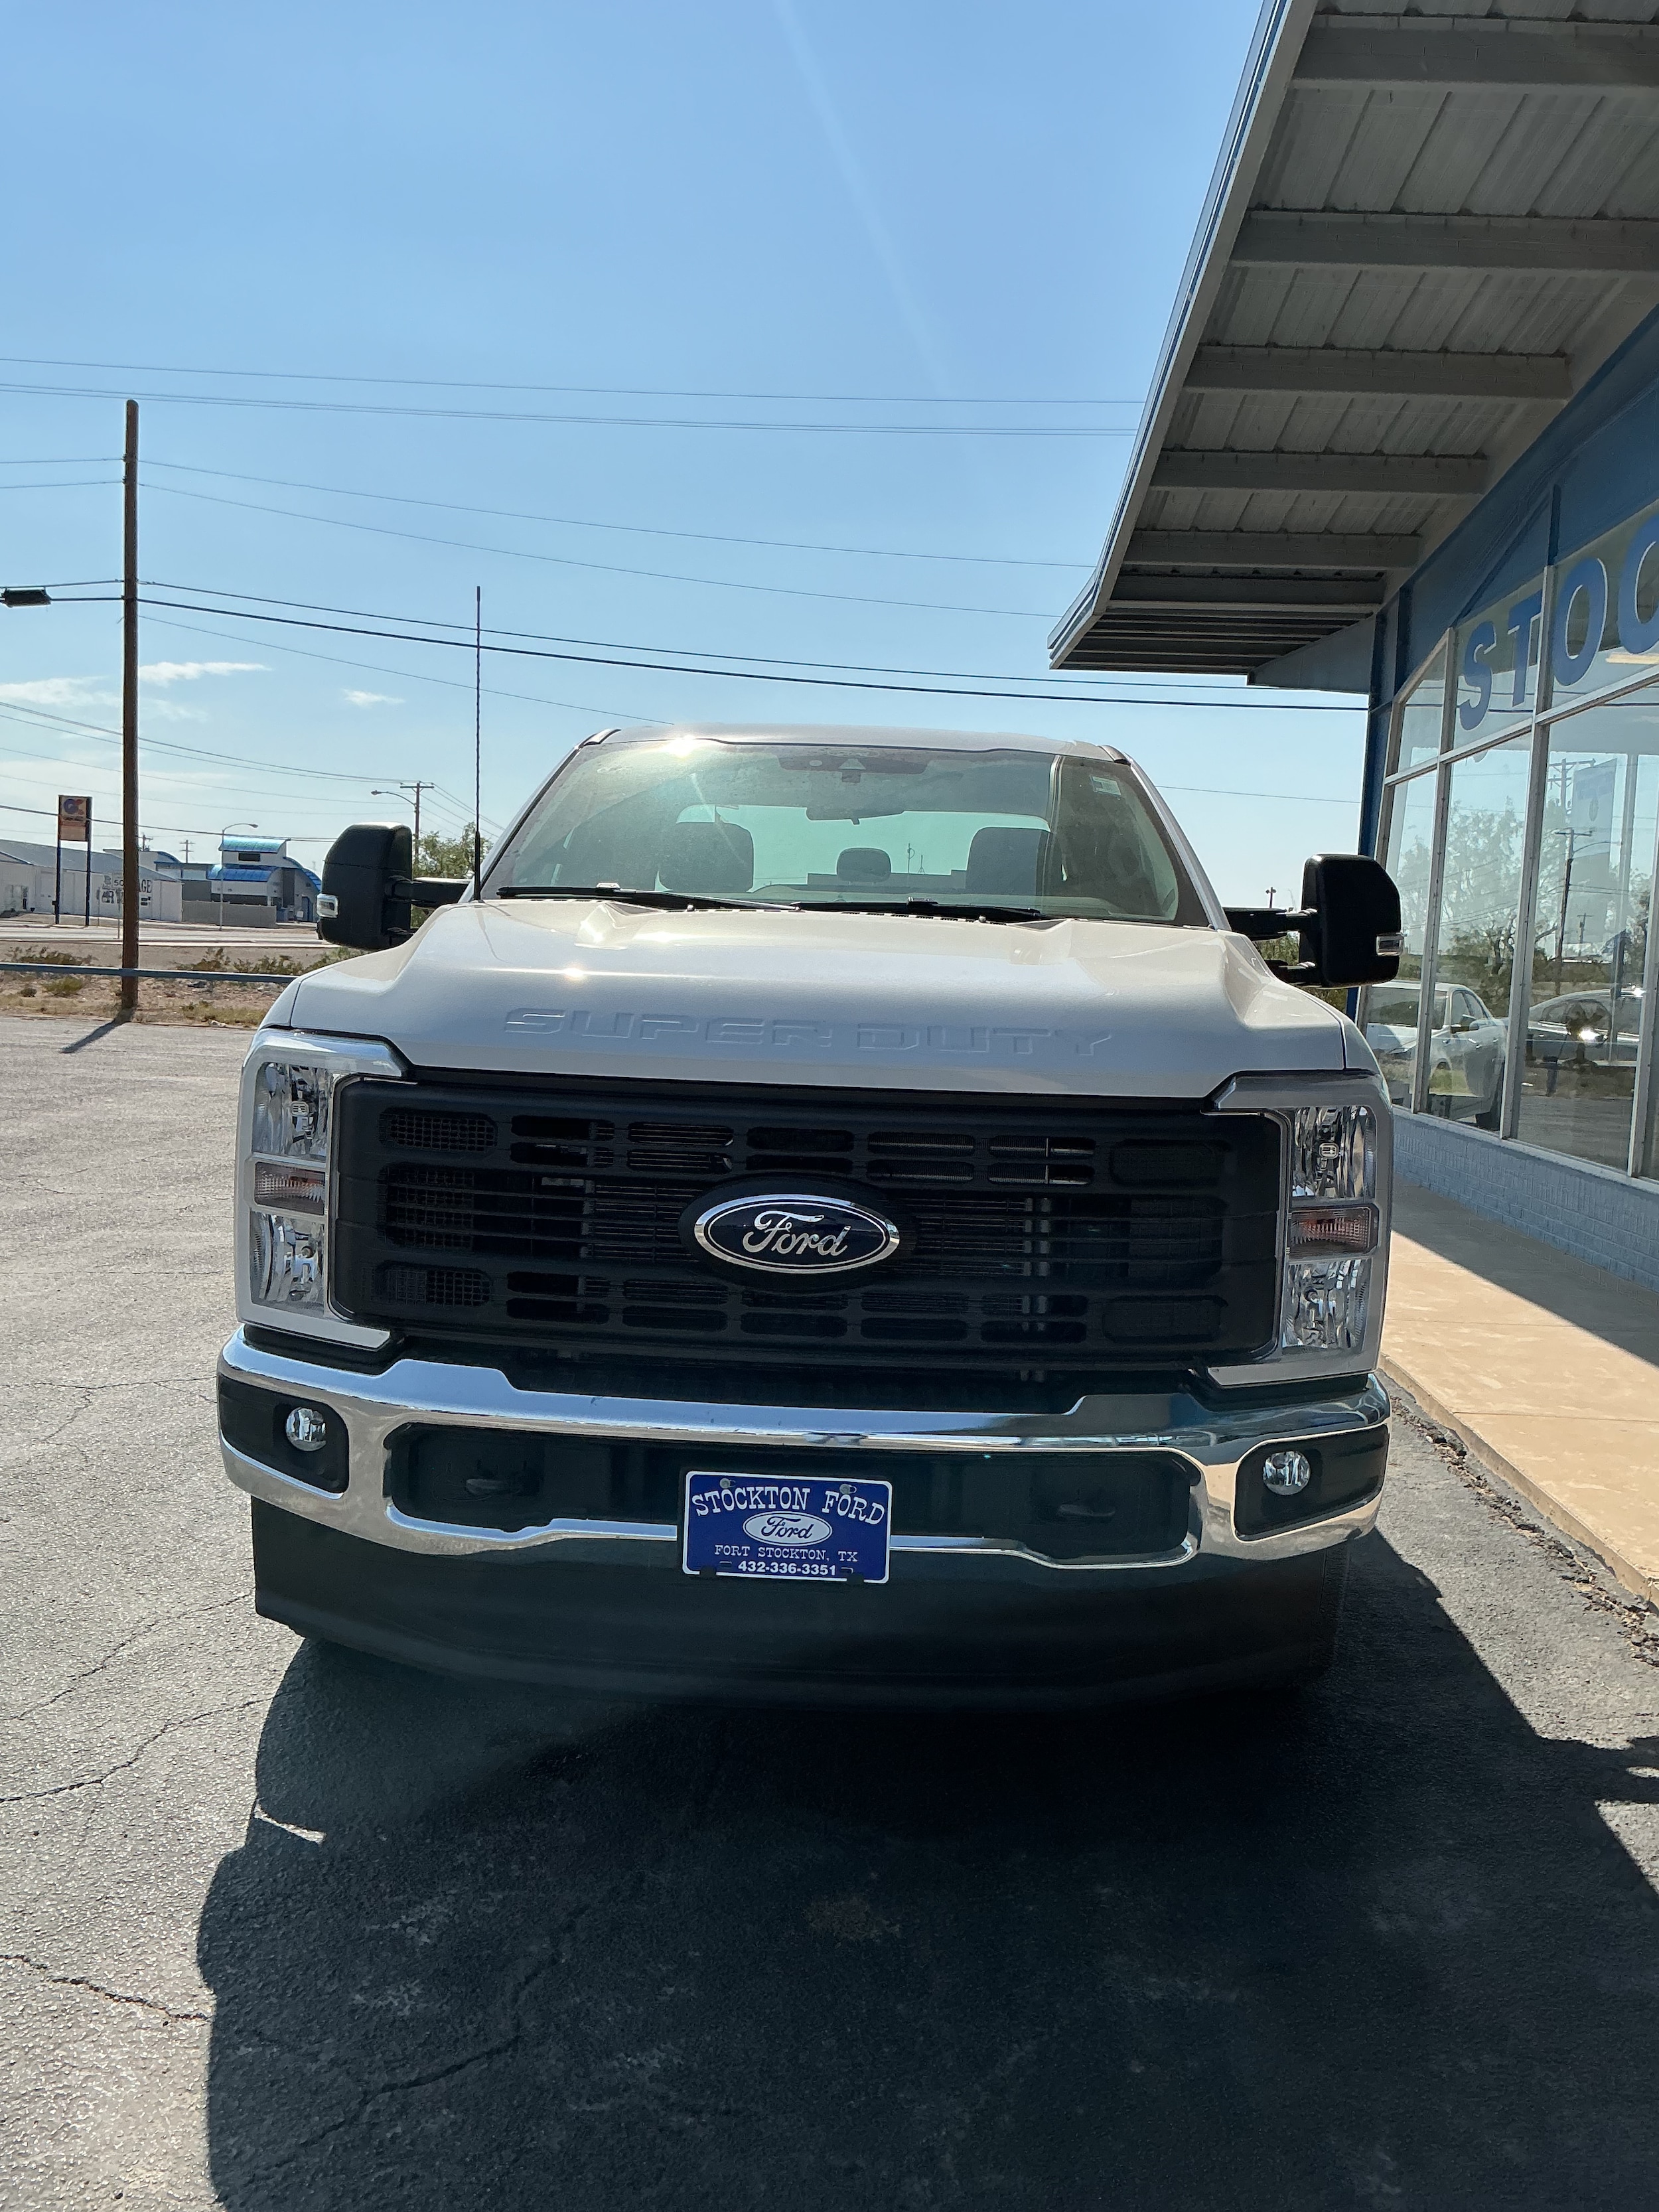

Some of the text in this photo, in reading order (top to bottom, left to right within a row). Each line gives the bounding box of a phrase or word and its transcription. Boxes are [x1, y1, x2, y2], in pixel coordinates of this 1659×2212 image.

[505, 1007, 1112, 1056] SUPER DUTY
[742, 1210, 851, 1256] Ford
[691, 1486, 885, 1524] STOCKTON FORD
[760, 1516, 814, 1540] Ford
[714, 1544, 751, 1557] FORT
[838, 1551, 858, 1562] TX
[738, 1560, 836, 1576] 432-336-3351
